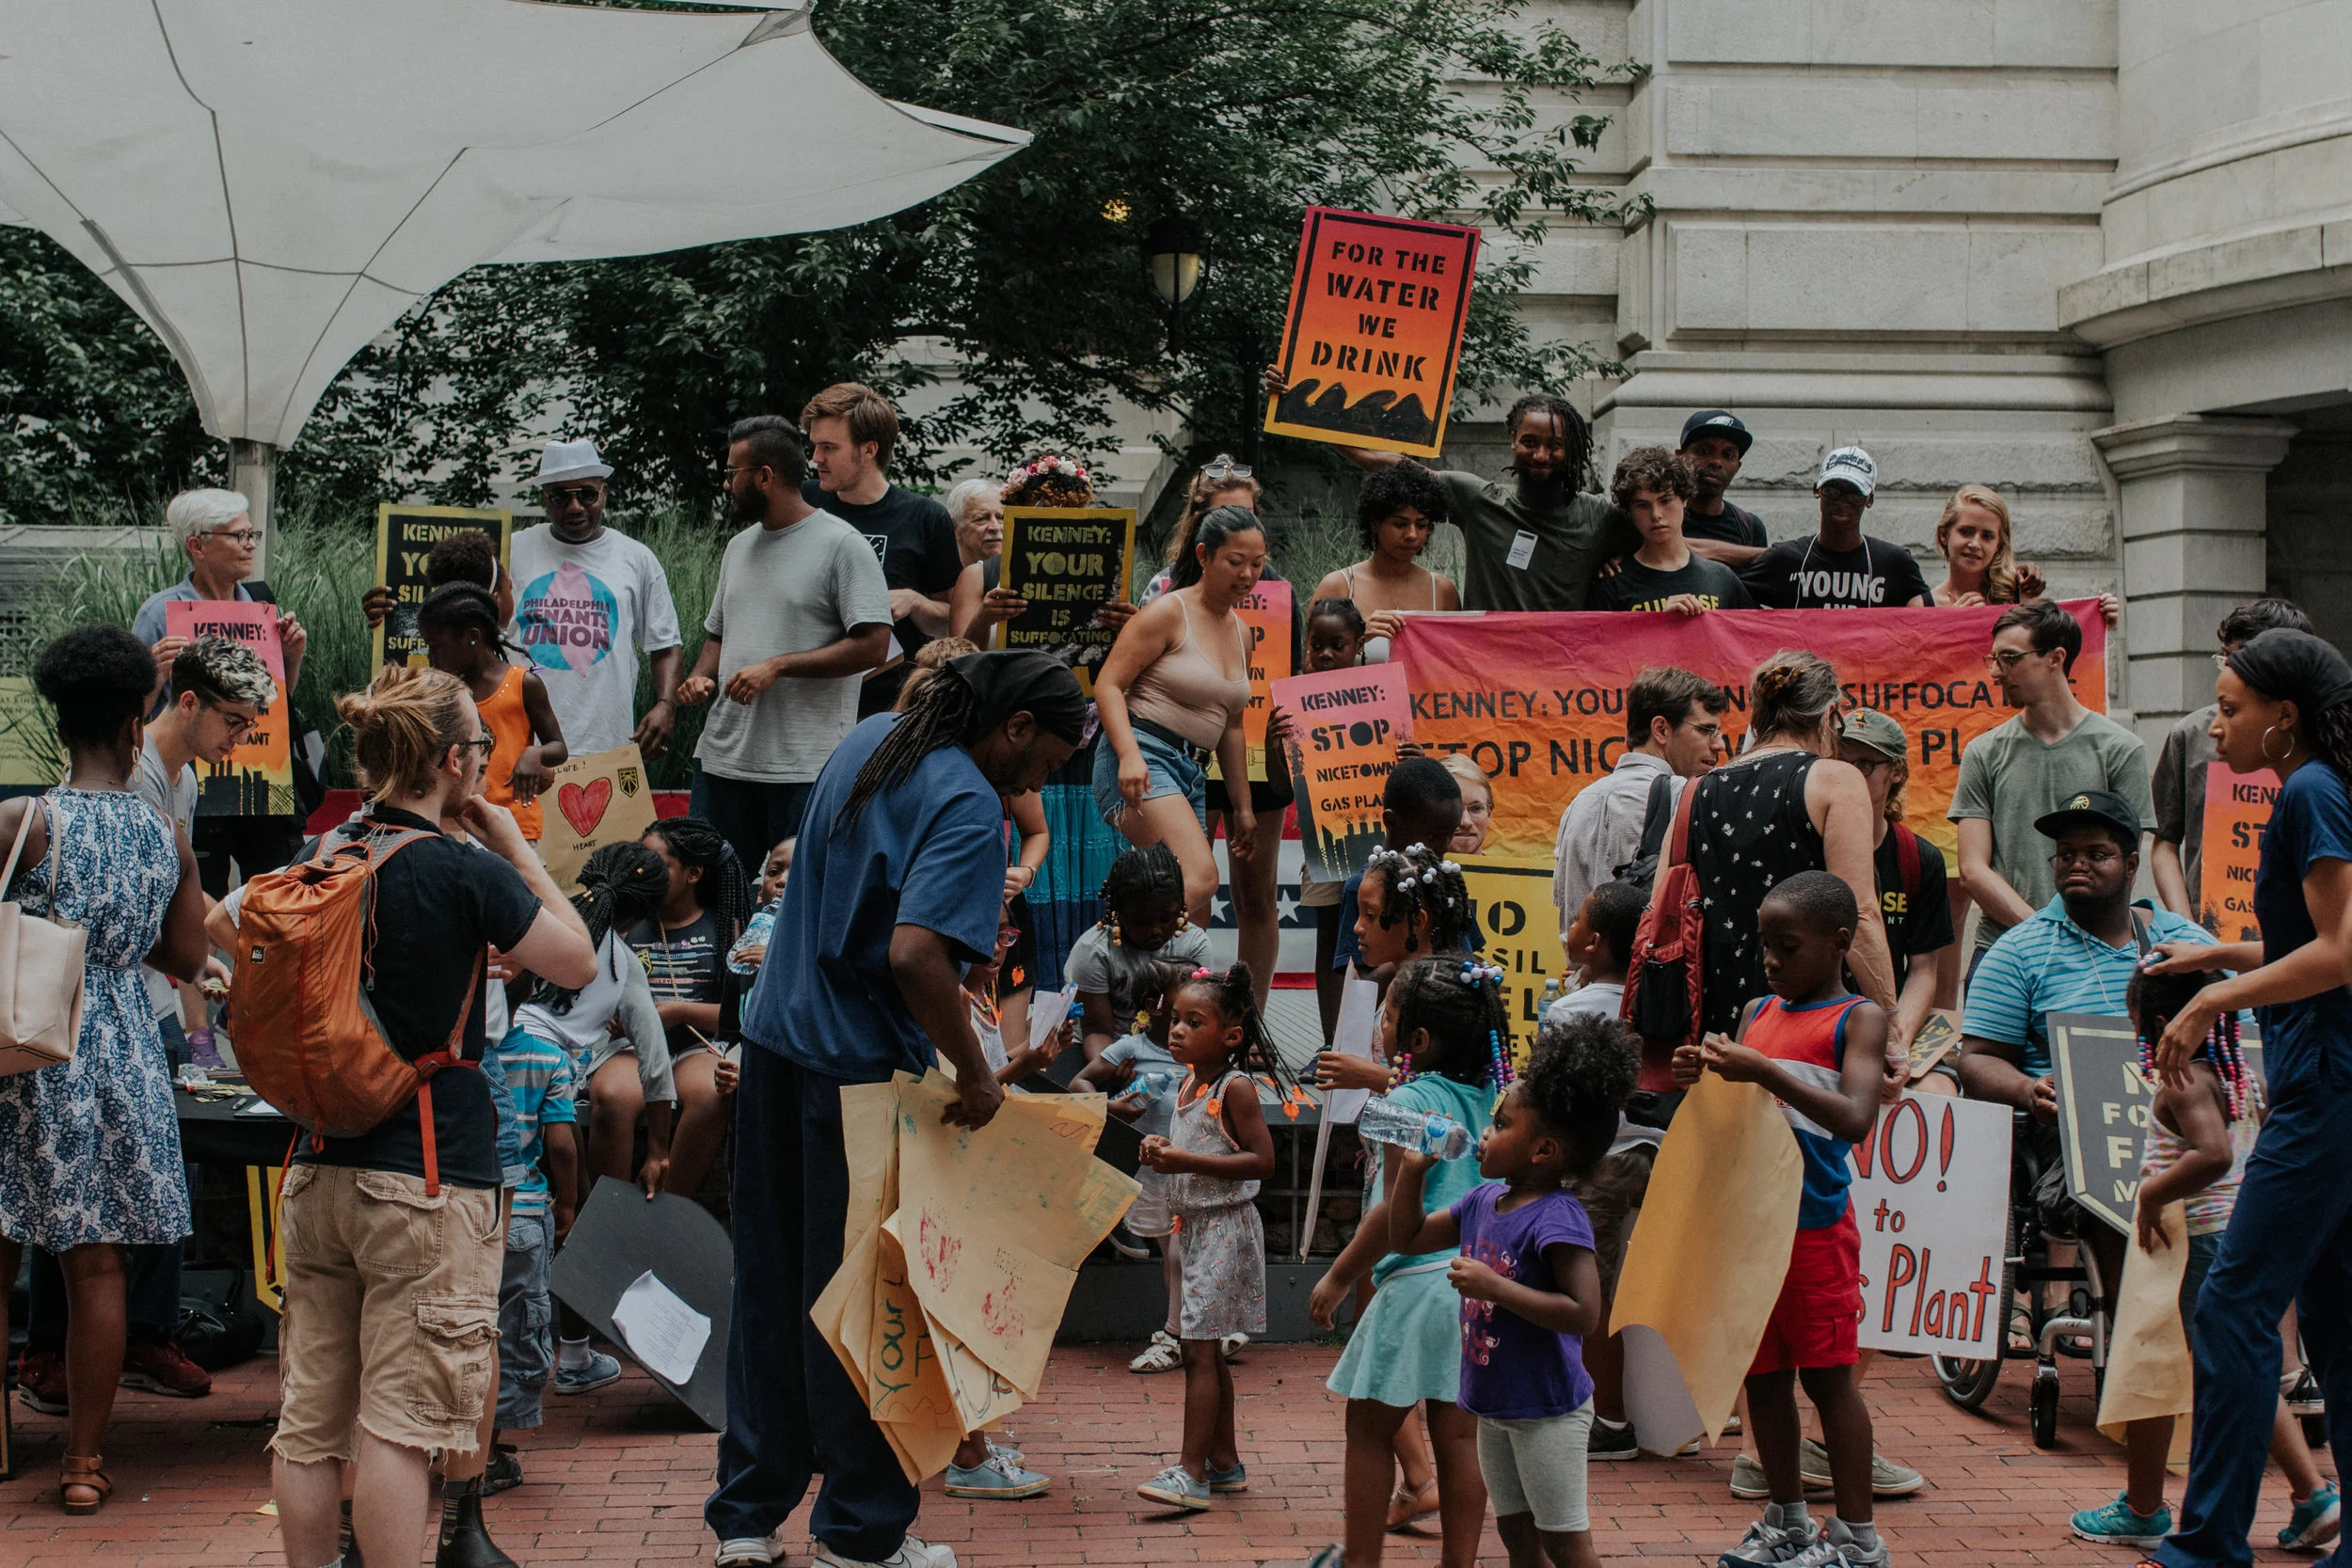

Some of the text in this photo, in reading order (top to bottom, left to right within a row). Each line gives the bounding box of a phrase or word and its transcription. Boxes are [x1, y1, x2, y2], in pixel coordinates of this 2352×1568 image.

[1331, 241, 1446, 275] FOR THE
[1327, 272, 1439, 310] WATER
[1359, 313, 1397, 339] WE
[1311, 341, 1427, 382] DRINK
[403, 523, 485, 543] KENN
[1027, 525, 1112, 545] KENNEY:
[1025, 551, 1104, 577] YOUR
[1021, 582, 1106, 602] SILENCE
[523, 597, 611, 613] PHILADELPHIA
[523, 609, 610, 629] TENANTS
[1051, 609, 1072, 626] IS
[194, 622, 267, 641] KENNEY:
[522, 625, 610, 652] UNION
[1009, 630, 1114, 645] SUFFOCATING
[1300, 684, 1386, 712] KENNEY:
[1410, 689, 1549, 721] KENNEY:
[1553, 688, 1625, 717] YOU
[246, 732, 271, 746] ANT
[1311, 719, 1391, 752] STOP
[1316, 760, 1397, 783] NICETOWN
[1320, 792, 1386, 813] GAS PLA
[572, 839, 597, 852] HEART
[2232, 820, 2268, 851] ST
[1873, 1198, 1906, 1233] to
[1882, 1243, 1995, 1342] Plant
